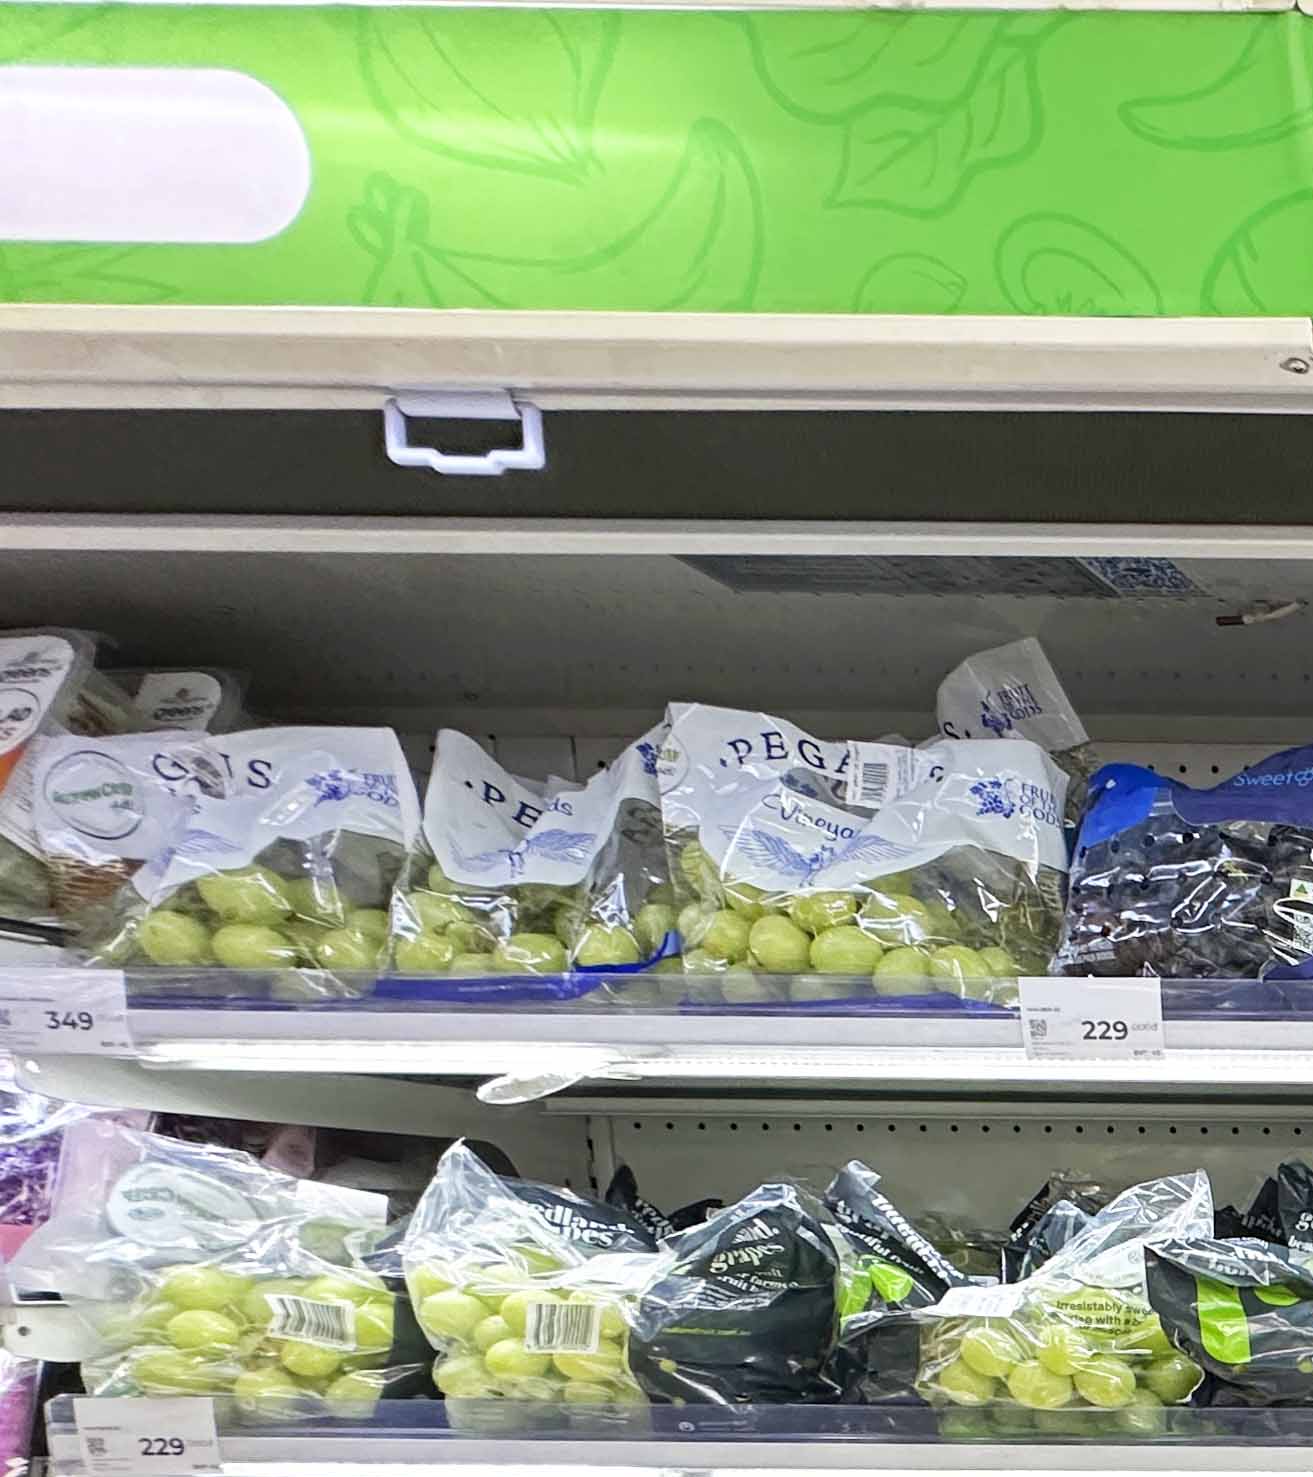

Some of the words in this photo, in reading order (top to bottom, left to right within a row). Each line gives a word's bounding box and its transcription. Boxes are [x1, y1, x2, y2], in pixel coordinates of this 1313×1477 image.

[44, 1010, 93, 1030] 349
[1081, 1021, 1129, 1041] 229
[138, 1438, 185, 1456] 229
